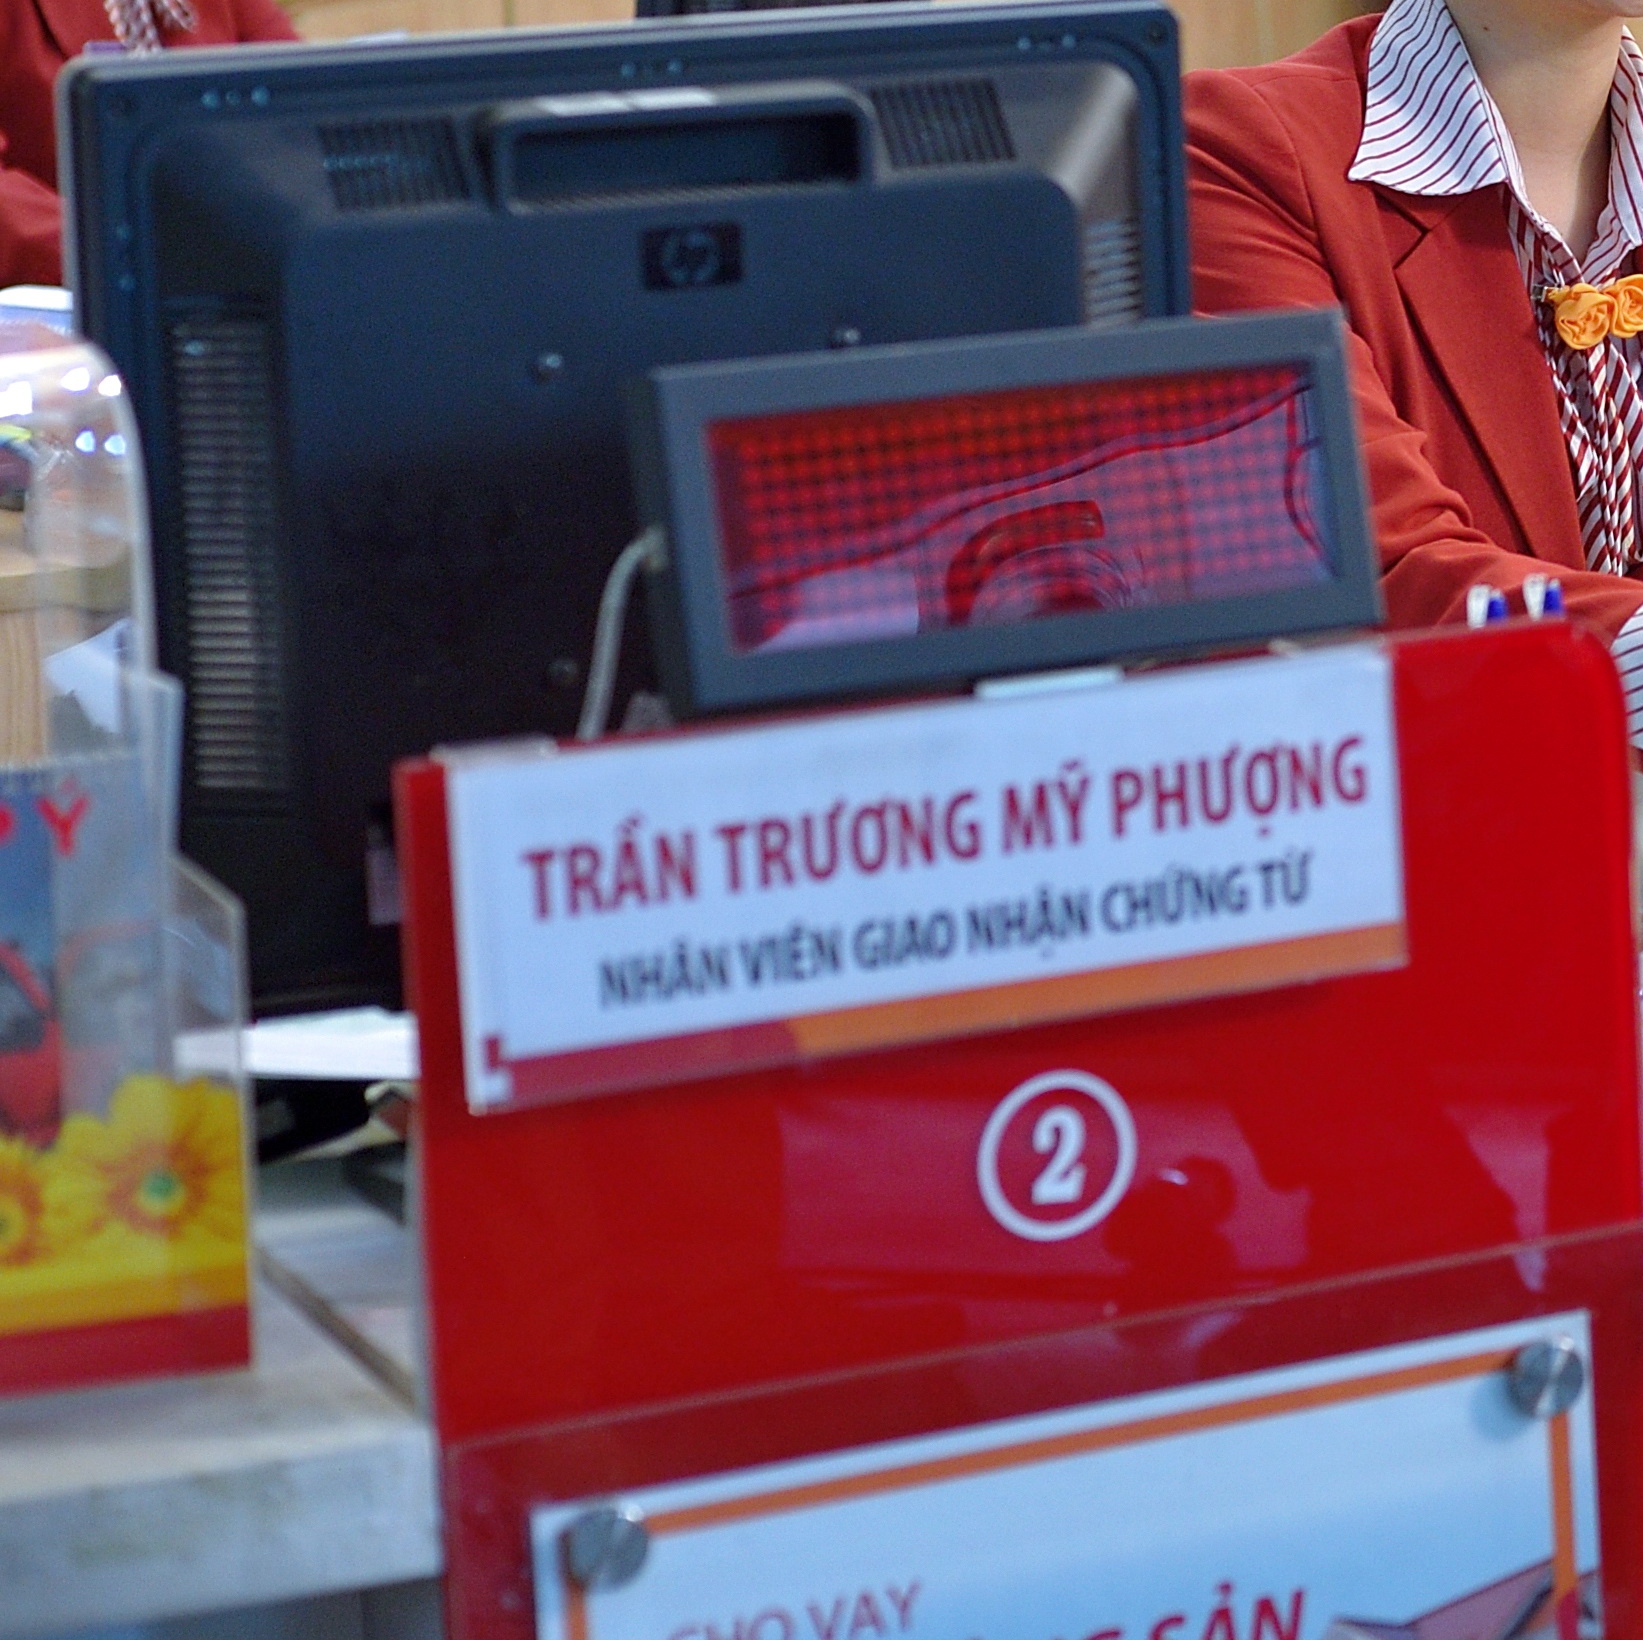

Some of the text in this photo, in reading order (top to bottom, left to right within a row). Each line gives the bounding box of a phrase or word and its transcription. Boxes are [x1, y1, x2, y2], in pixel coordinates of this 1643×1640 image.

[714, 790, 980, 893] TRƯƠNG
[1003, 759, 1089, 851] MỸ
[1112, 735, 1366, 838] PHƯỢNG
[601, 937, 729, 1008] NHÂN
[740, 921, 840, 986] VIÊN
[853, 908, 956, 970] GIAO
[1030, 1107, 1085, 1204] 2
[805, 1578, 922, 1640] VAY
